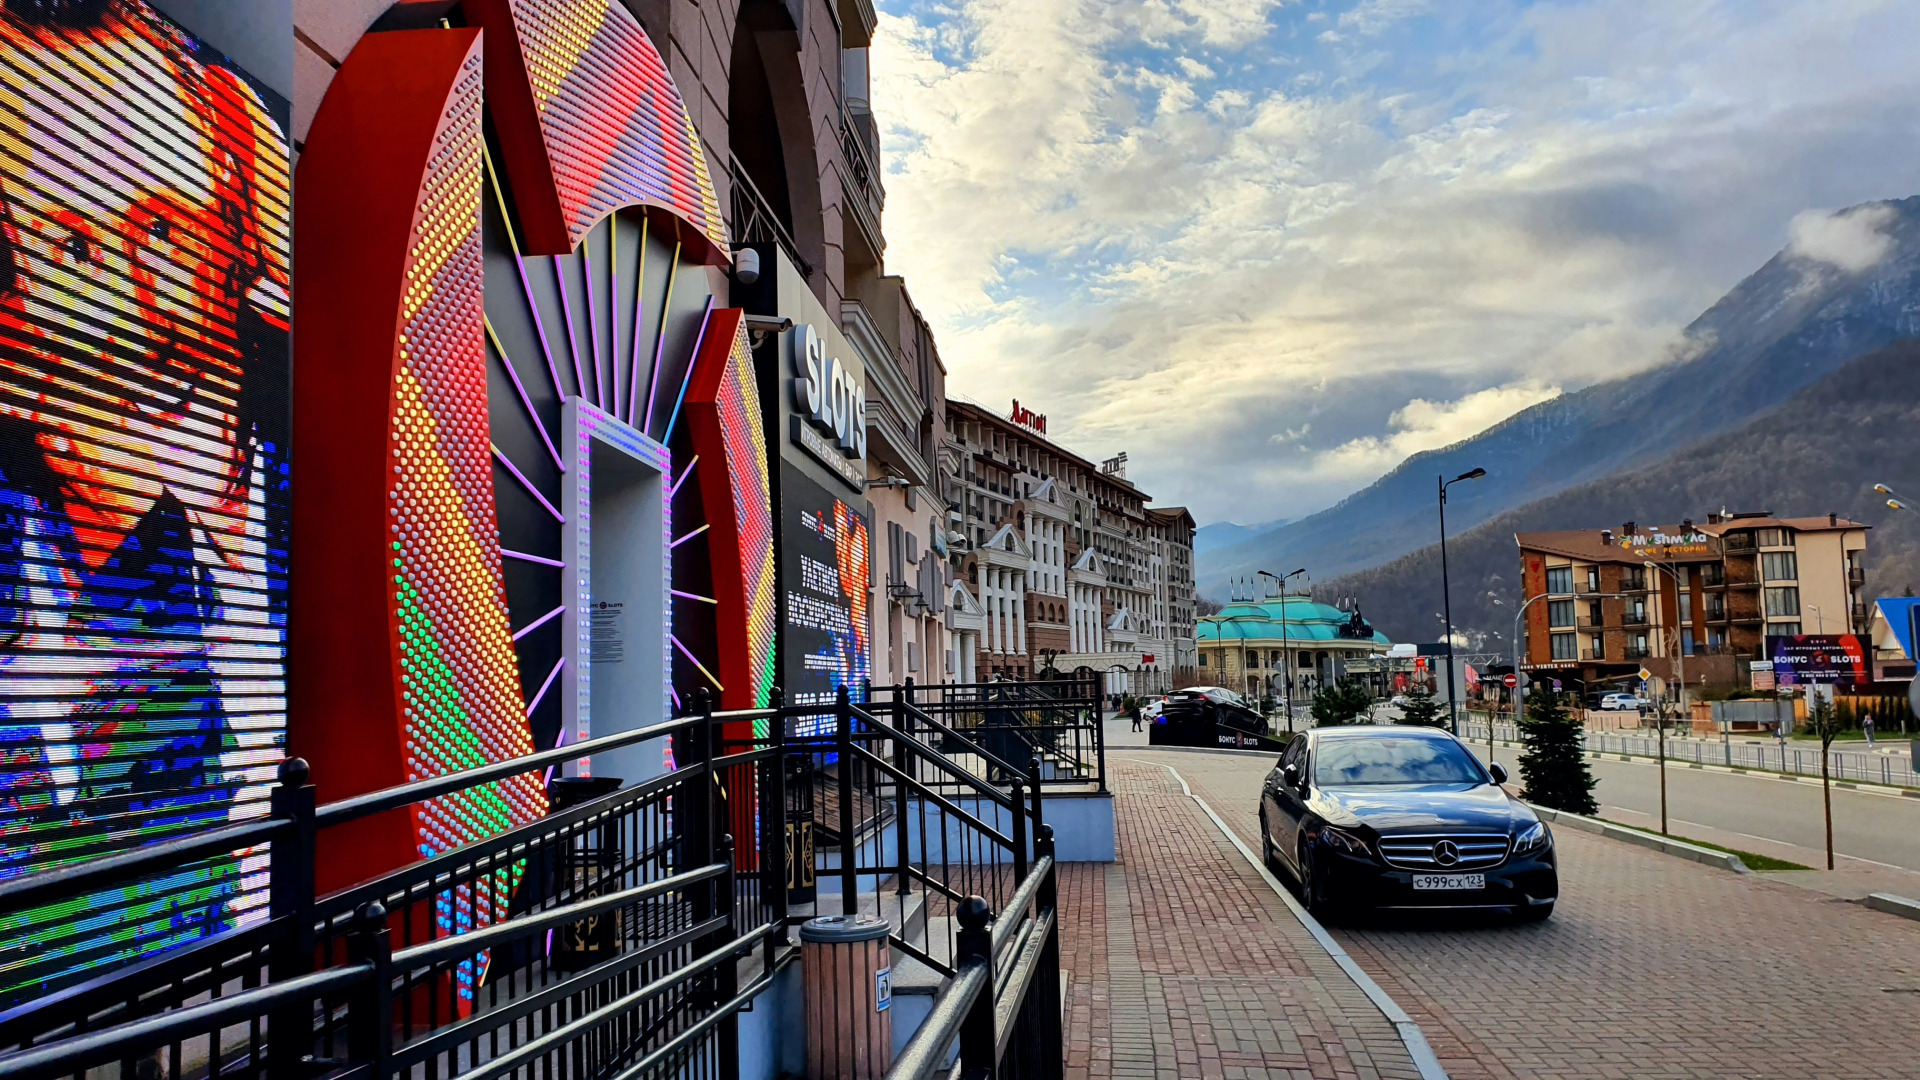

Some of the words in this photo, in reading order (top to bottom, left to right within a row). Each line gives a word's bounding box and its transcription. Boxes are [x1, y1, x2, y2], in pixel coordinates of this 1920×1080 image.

[803, 323, 866, 460] SLOTS
[1219, 735, 1235, 744] БОНУС
[1244, 738, 1258, 746] SLOTS
